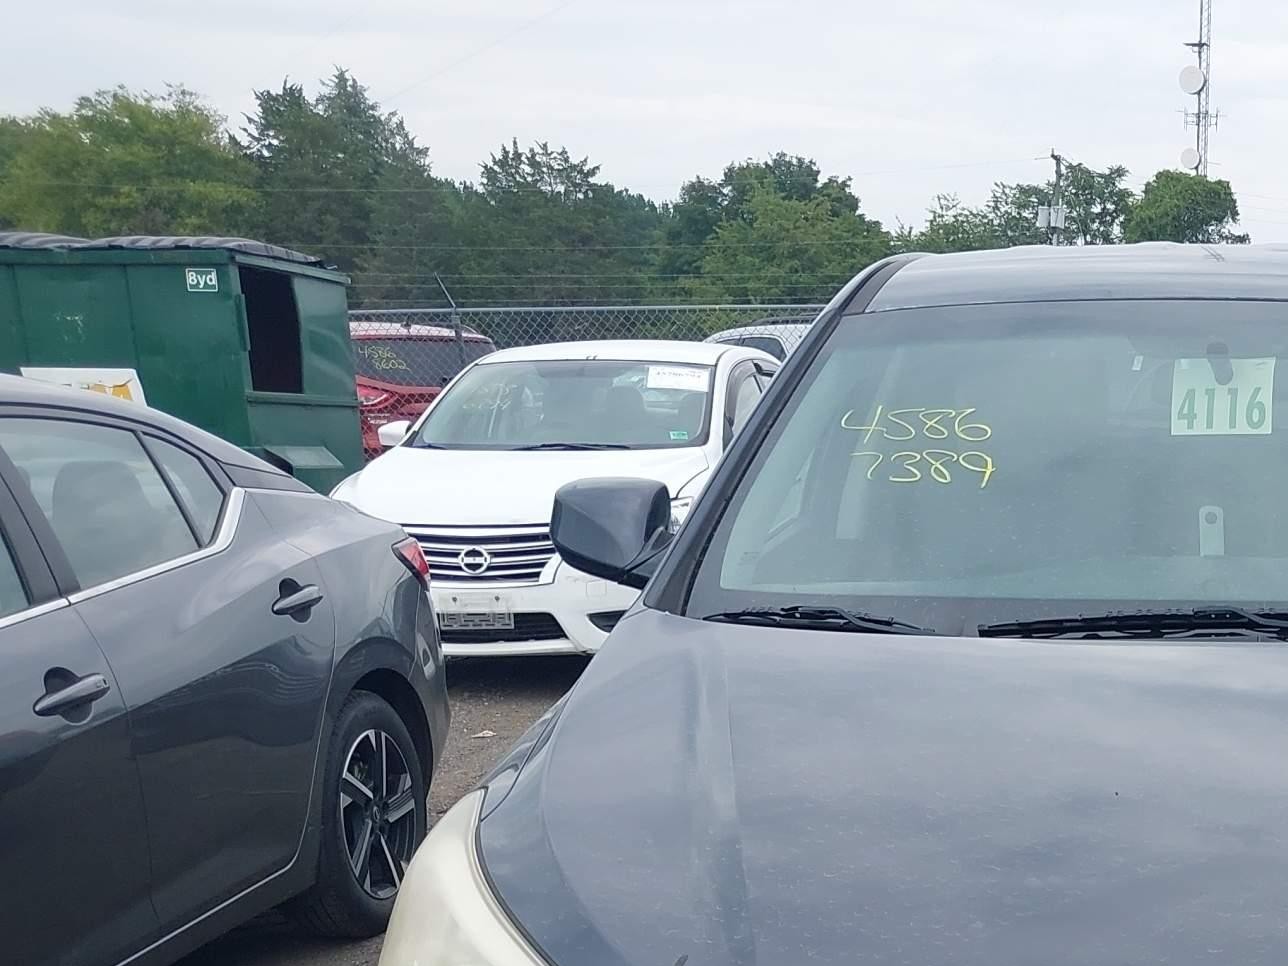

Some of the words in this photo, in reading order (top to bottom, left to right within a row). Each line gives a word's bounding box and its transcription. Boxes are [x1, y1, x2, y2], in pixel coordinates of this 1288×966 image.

[188, 271, 216, 289] 8yd
[840, 404, 992, 444] 4586
[1176, 386, 1266, 431] 4116
[850, 449, 997, 489] 7389
